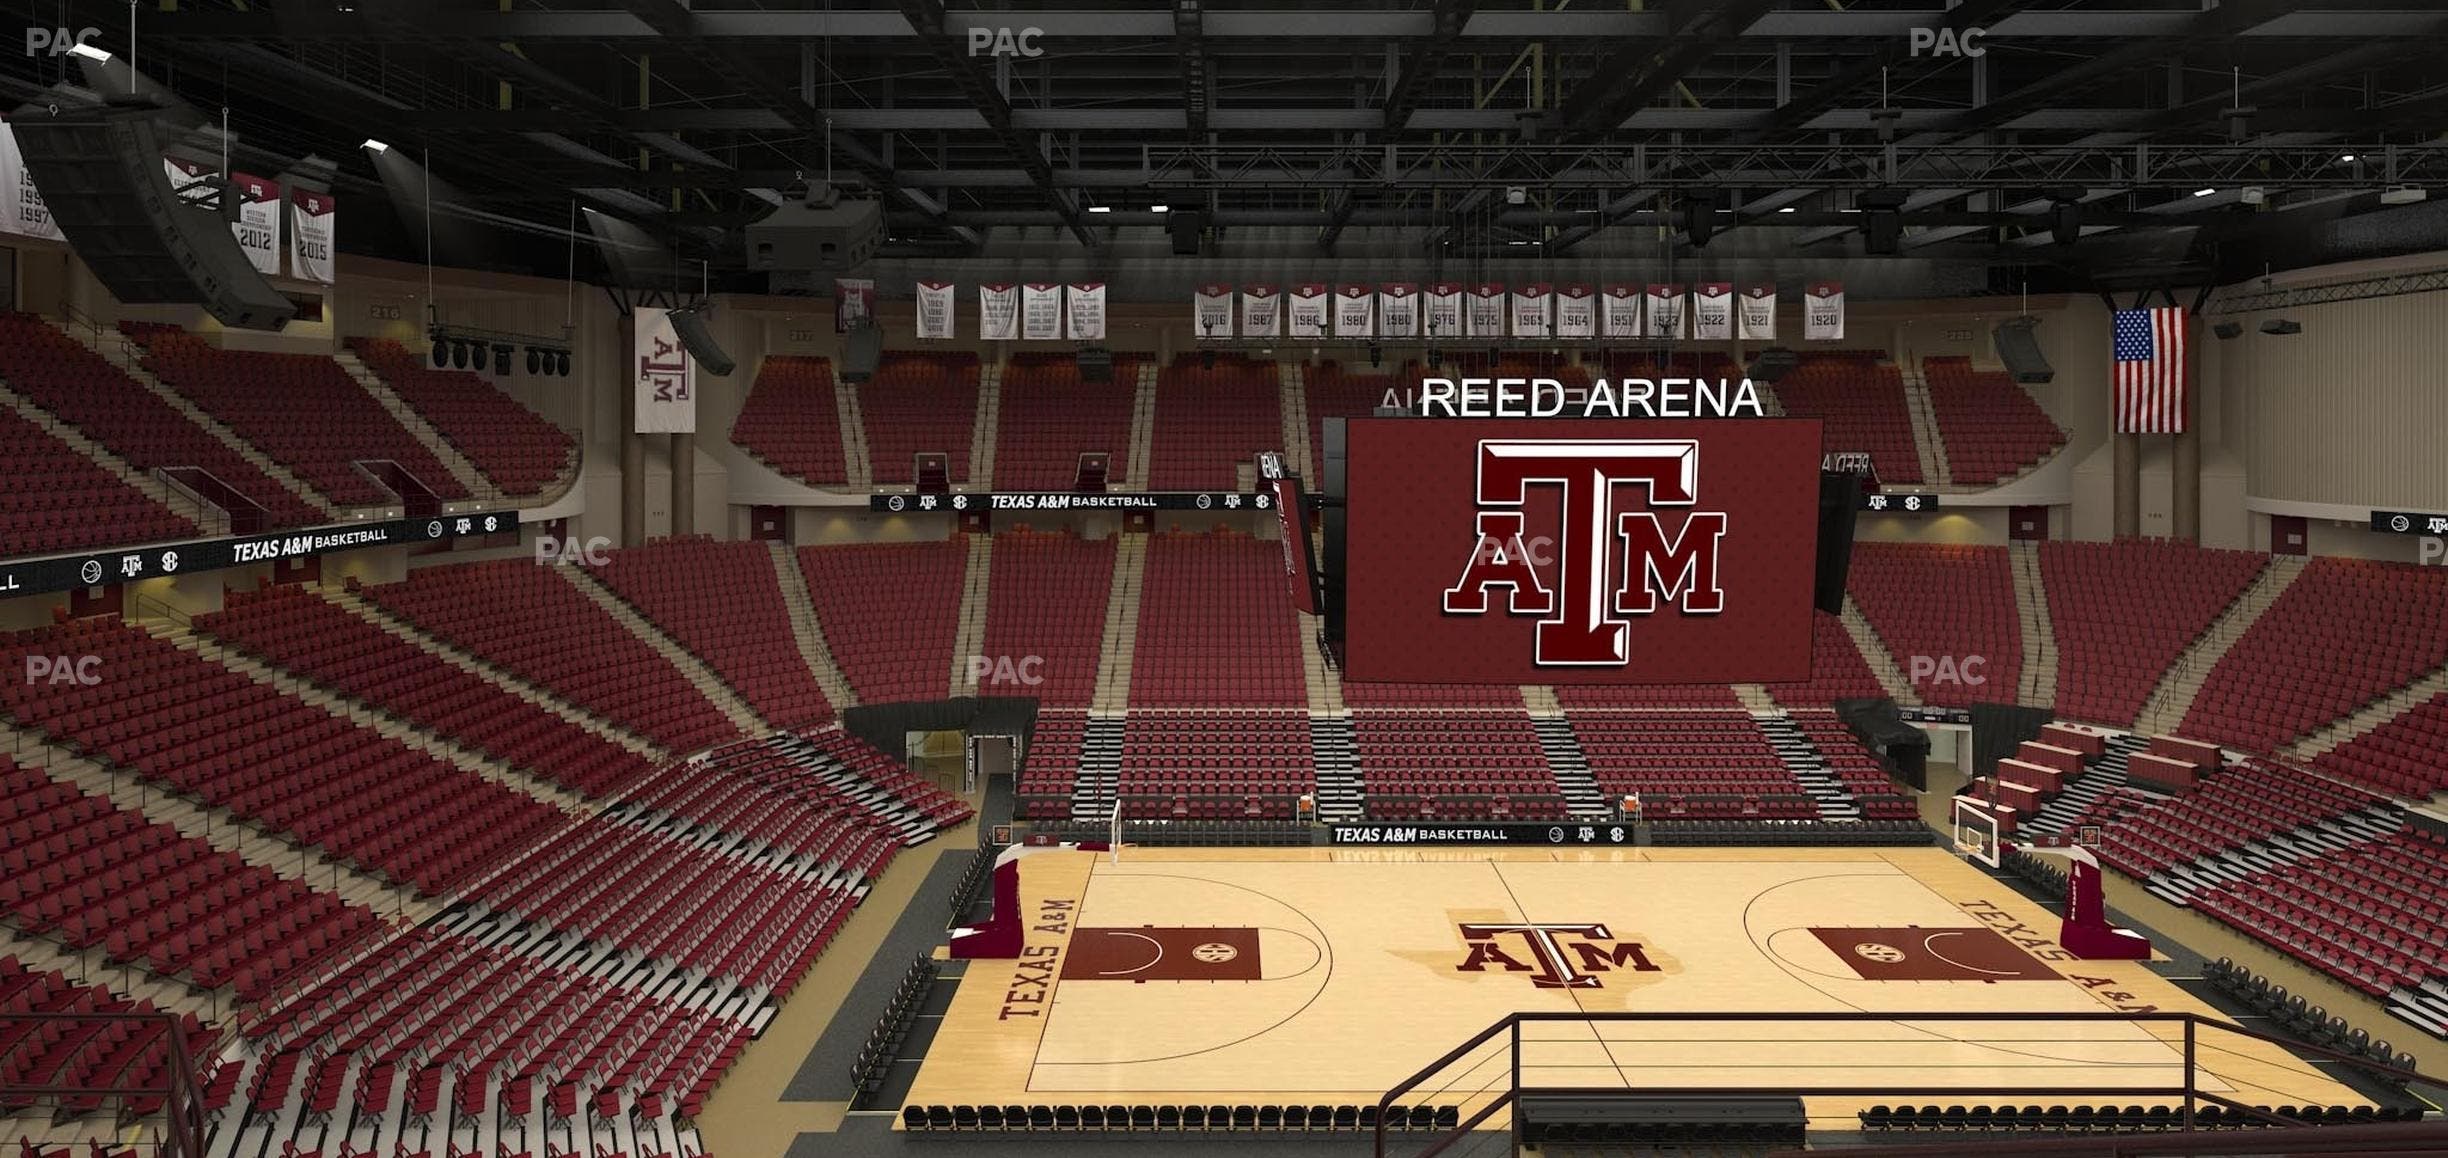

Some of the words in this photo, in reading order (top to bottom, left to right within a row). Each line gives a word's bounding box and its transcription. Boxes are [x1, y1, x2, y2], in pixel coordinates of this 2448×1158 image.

[19, 206, 50, 224] 1997
[240, 228, 271, 250] 2012
[299, 238, 328, 261] 2015
[1811, 314, 1837, 326] 1920
[1422, 378, 1565, 418] REED
[1583, 378, 1764, 418] ARENA
[990, 495, 1035, 509] TEXAS
[1037, 495, 1070, 509] A&M
[1072, 496, 1157, 507] BASKETBALL
[233, 539, 280, 563] TEXAS
[281, 535, 313, 556] A&M
[315, 529, 388, 548] BASKETBALL
[1335, 828, 1380, 842] TEXAS
[1383, 828, 1417, 842] A&M
[1419, 829, 1508, 840] BASKETBALL
[1958, 899, 2081, 961] TEXAS
[998, 946, 1060, 1021] TEXAS
[1033, 900, 1076, 935] A&M
